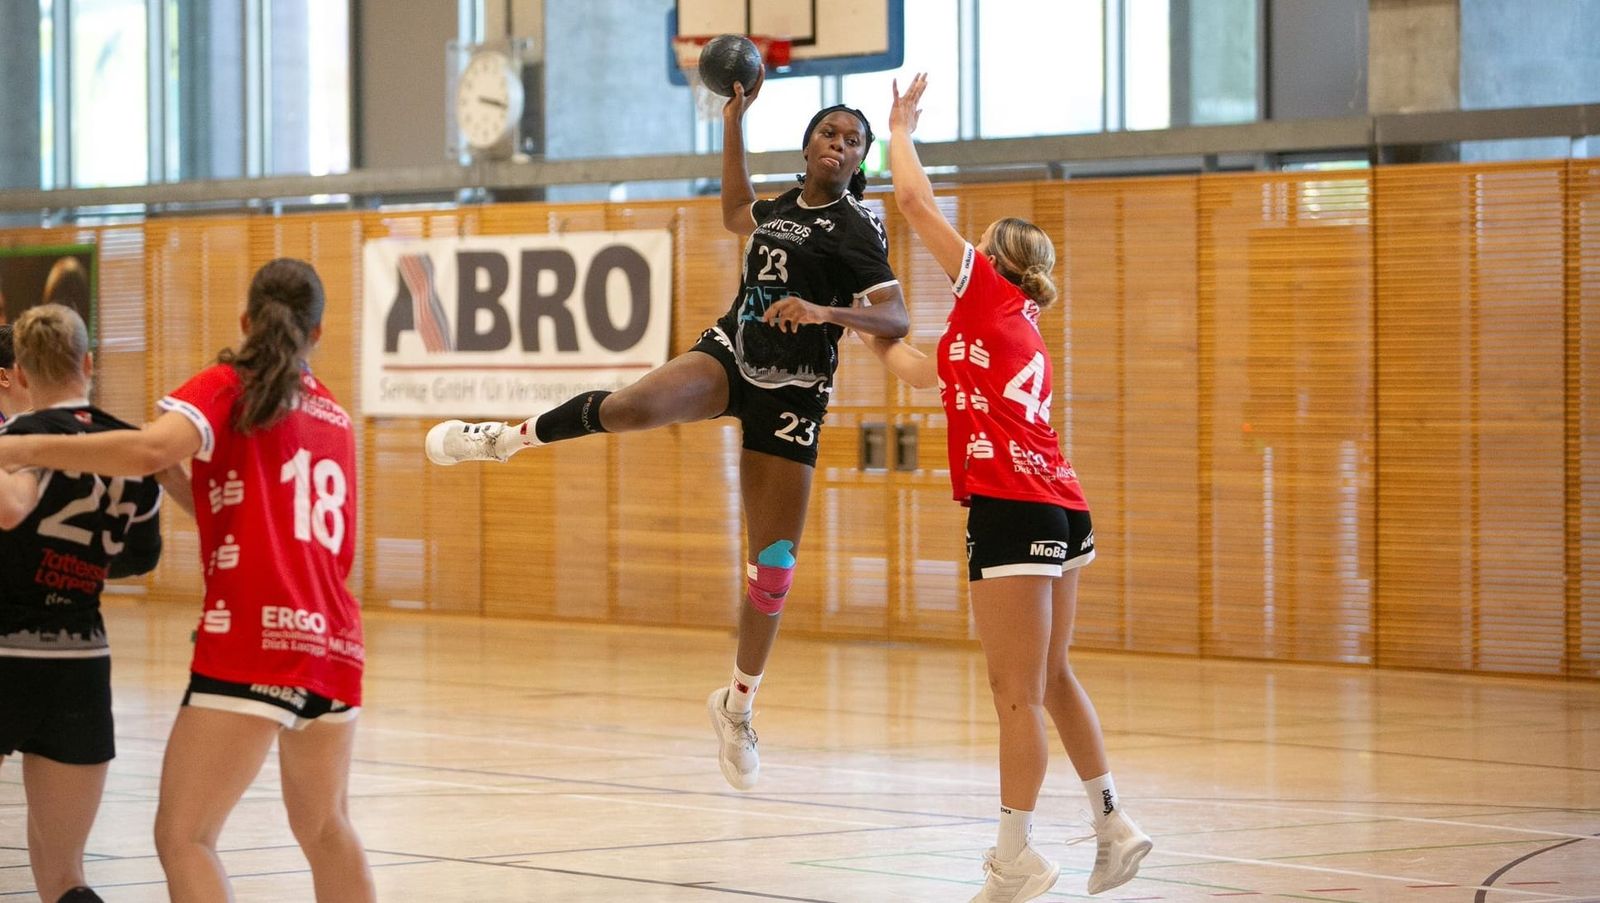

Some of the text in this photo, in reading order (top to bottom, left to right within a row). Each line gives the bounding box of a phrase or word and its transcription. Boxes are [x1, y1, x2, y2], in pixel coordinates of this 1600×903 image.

[757, 245, 789, 283] 23
[384, 244, 652, 354] ABRO
[774, 412, 816, 447] 23
[280, 447, 347, 556] 18
[261, 605, 327, 635] ERGO
